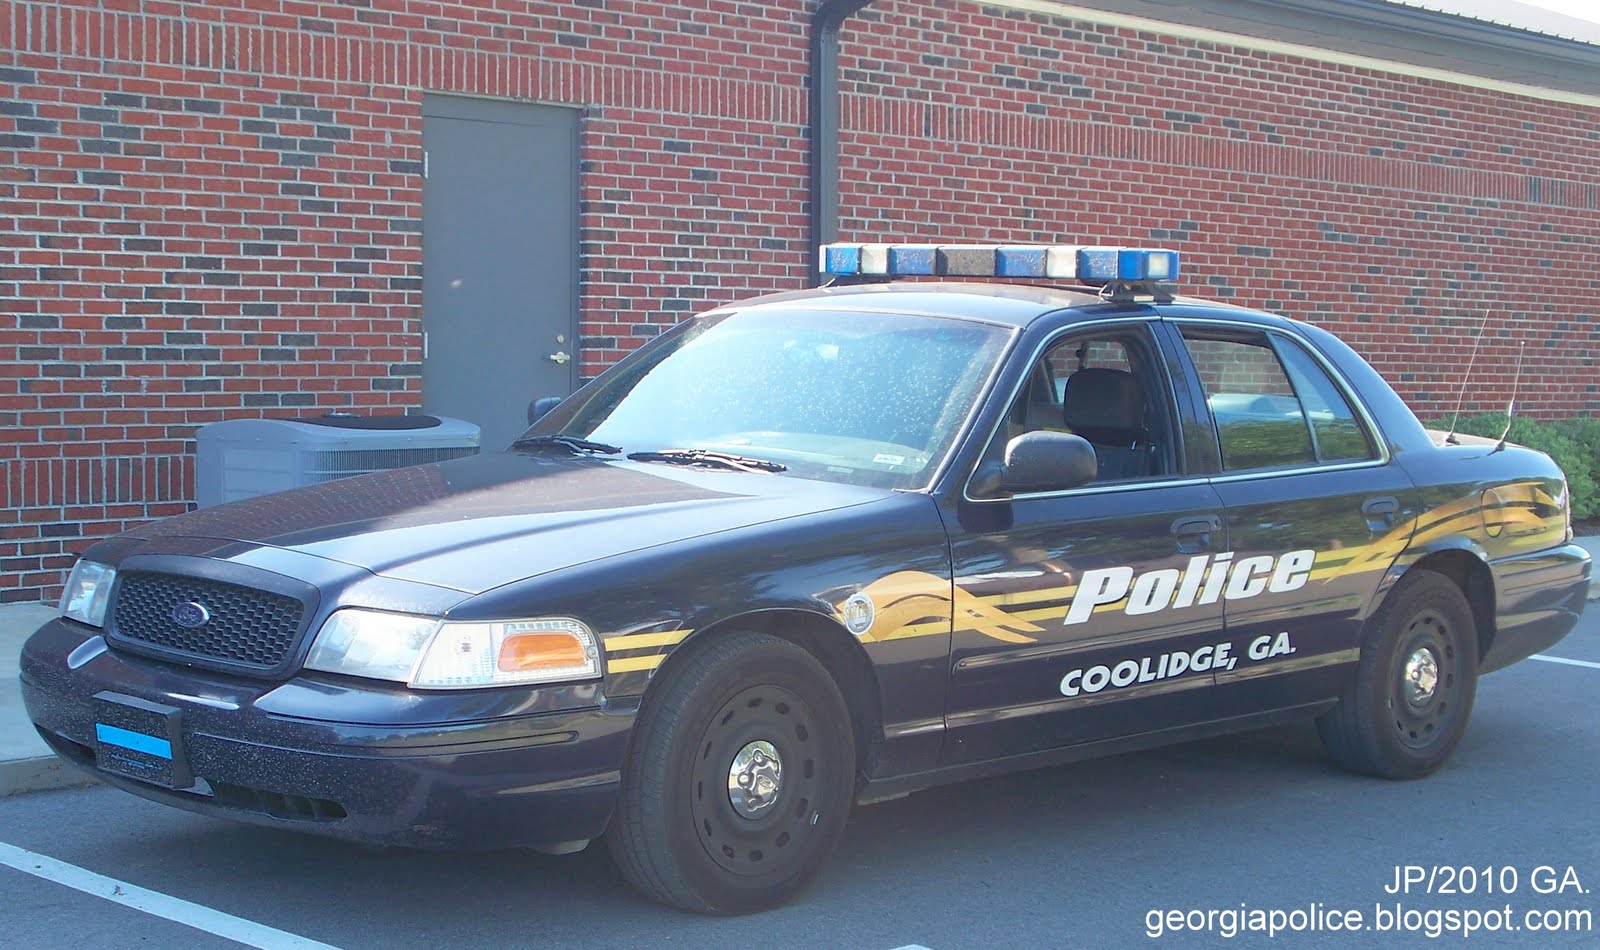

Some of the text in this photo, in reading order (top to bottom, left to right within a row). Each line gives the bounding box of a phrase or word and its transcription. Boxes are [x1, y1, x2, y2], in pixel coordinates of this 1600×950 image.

[1063, 549, 1316, 626] Police
[1059, 631, 1297, 697] COOLIDGE, GA.
